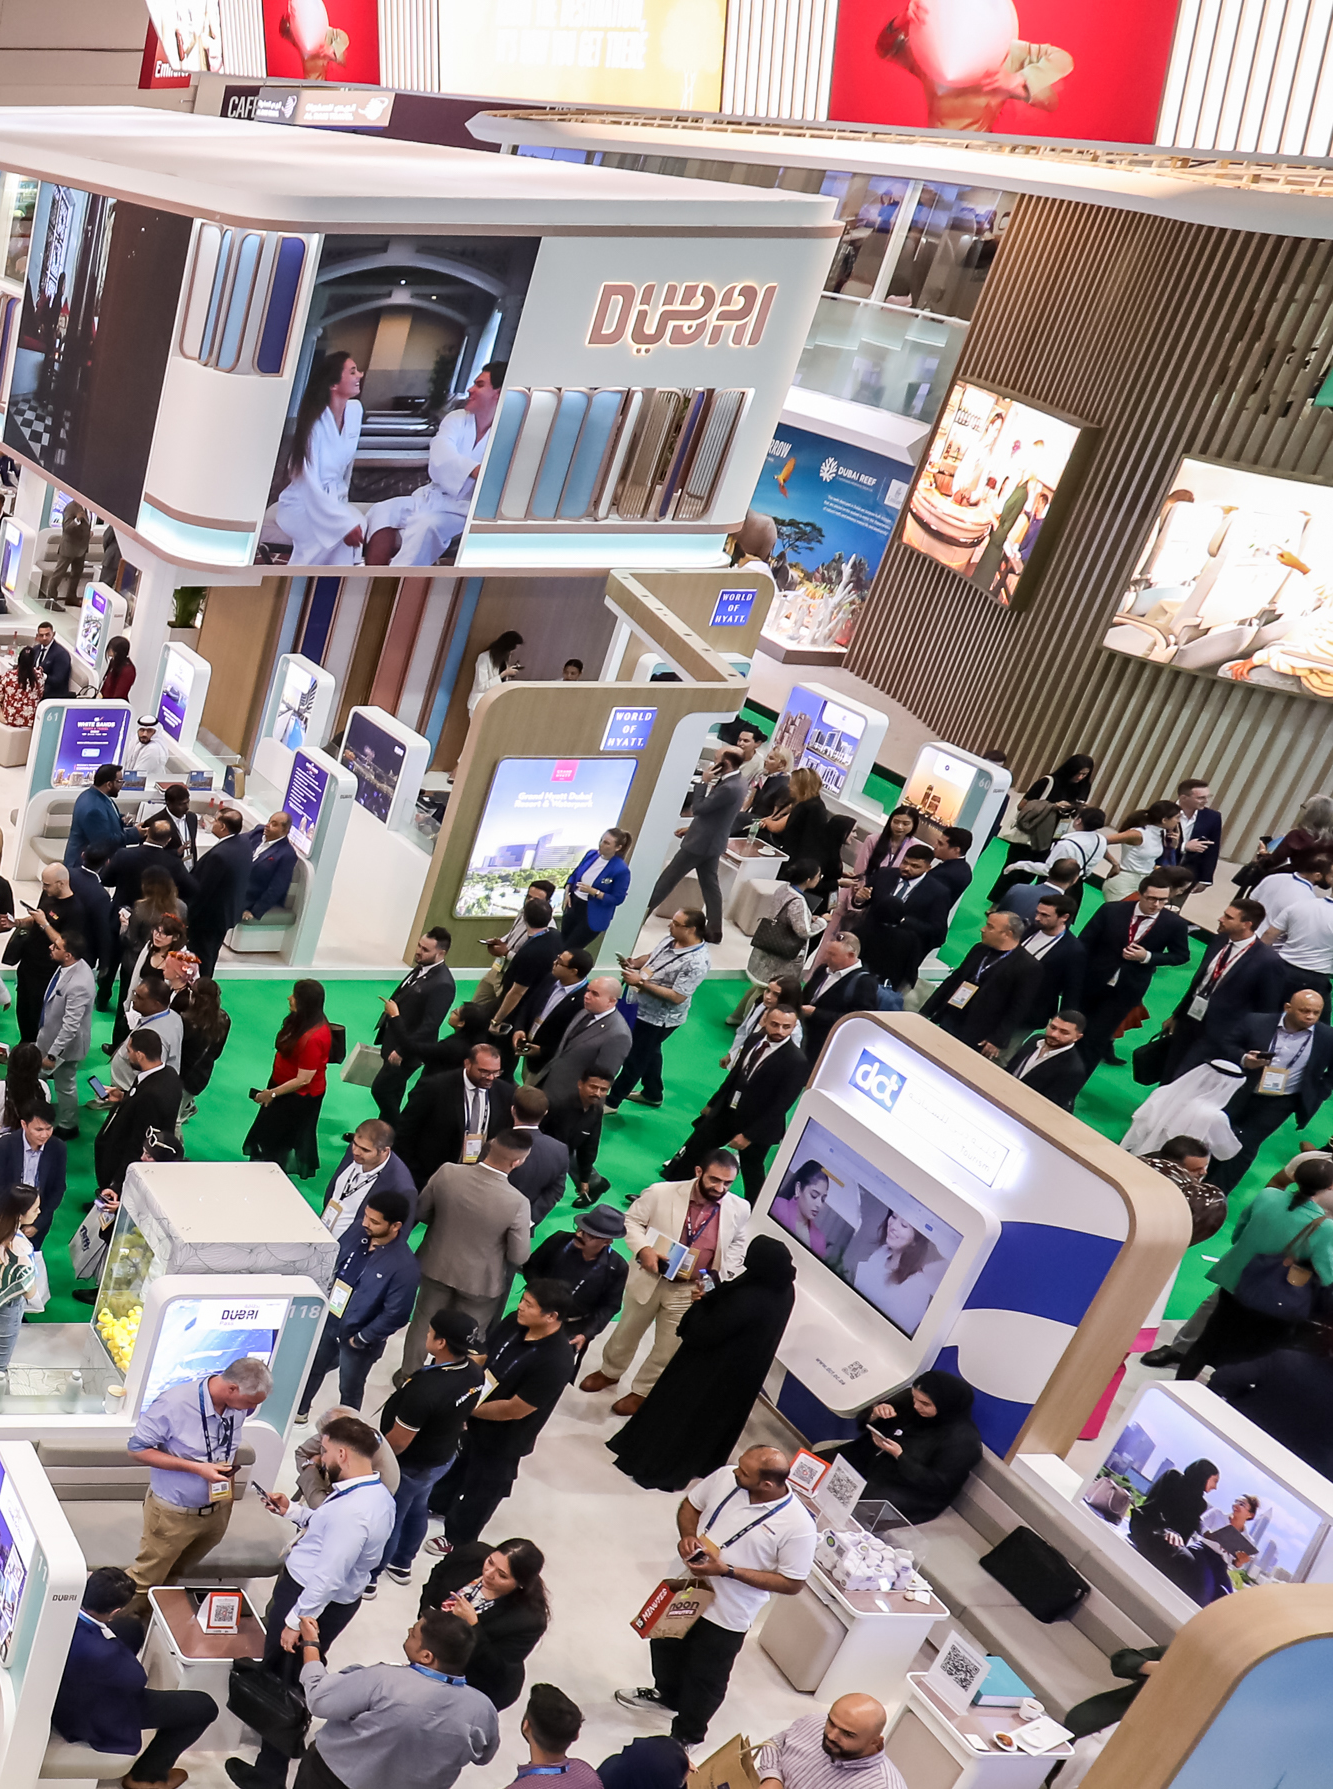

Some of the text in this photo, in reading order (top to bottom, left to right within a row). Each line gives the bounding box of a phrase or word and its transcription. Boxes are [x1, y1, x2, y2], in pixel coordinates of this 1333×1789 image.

[587, 282, 779, 357] DUBAI
[838, 466, 860, 481] DUBAI
[860, 473, 877, 487] REEF
[721, 593, 753, 602] WORLD
[727, 604, 741, 613] OF
[46, 711, 59, 723] 61
[615, 711, 653, 721] WORLD
[621, 724, 637, 734] OF
[978, 777, 991, 790] 60
[518, 791, 593, 802] Grand Hyatt Dubai
[514, 800, 540, 808] Resort
[552, 800, 594, 811] Waterpark
[854, 1060, 900, 1108] dct
[957, 1145, 993, 1173] Tourism
[221, 1309, 259, 1321] DUBAI
[288, 1304, 322, 1319] 118
[51, 1594, 78, 1602] DUBAI
[635, 1587, 668, 1629] 15 MINUTES
[669, 1601, 700, 1611] noon
[668, 1609, 696, 1617] MINUTES
